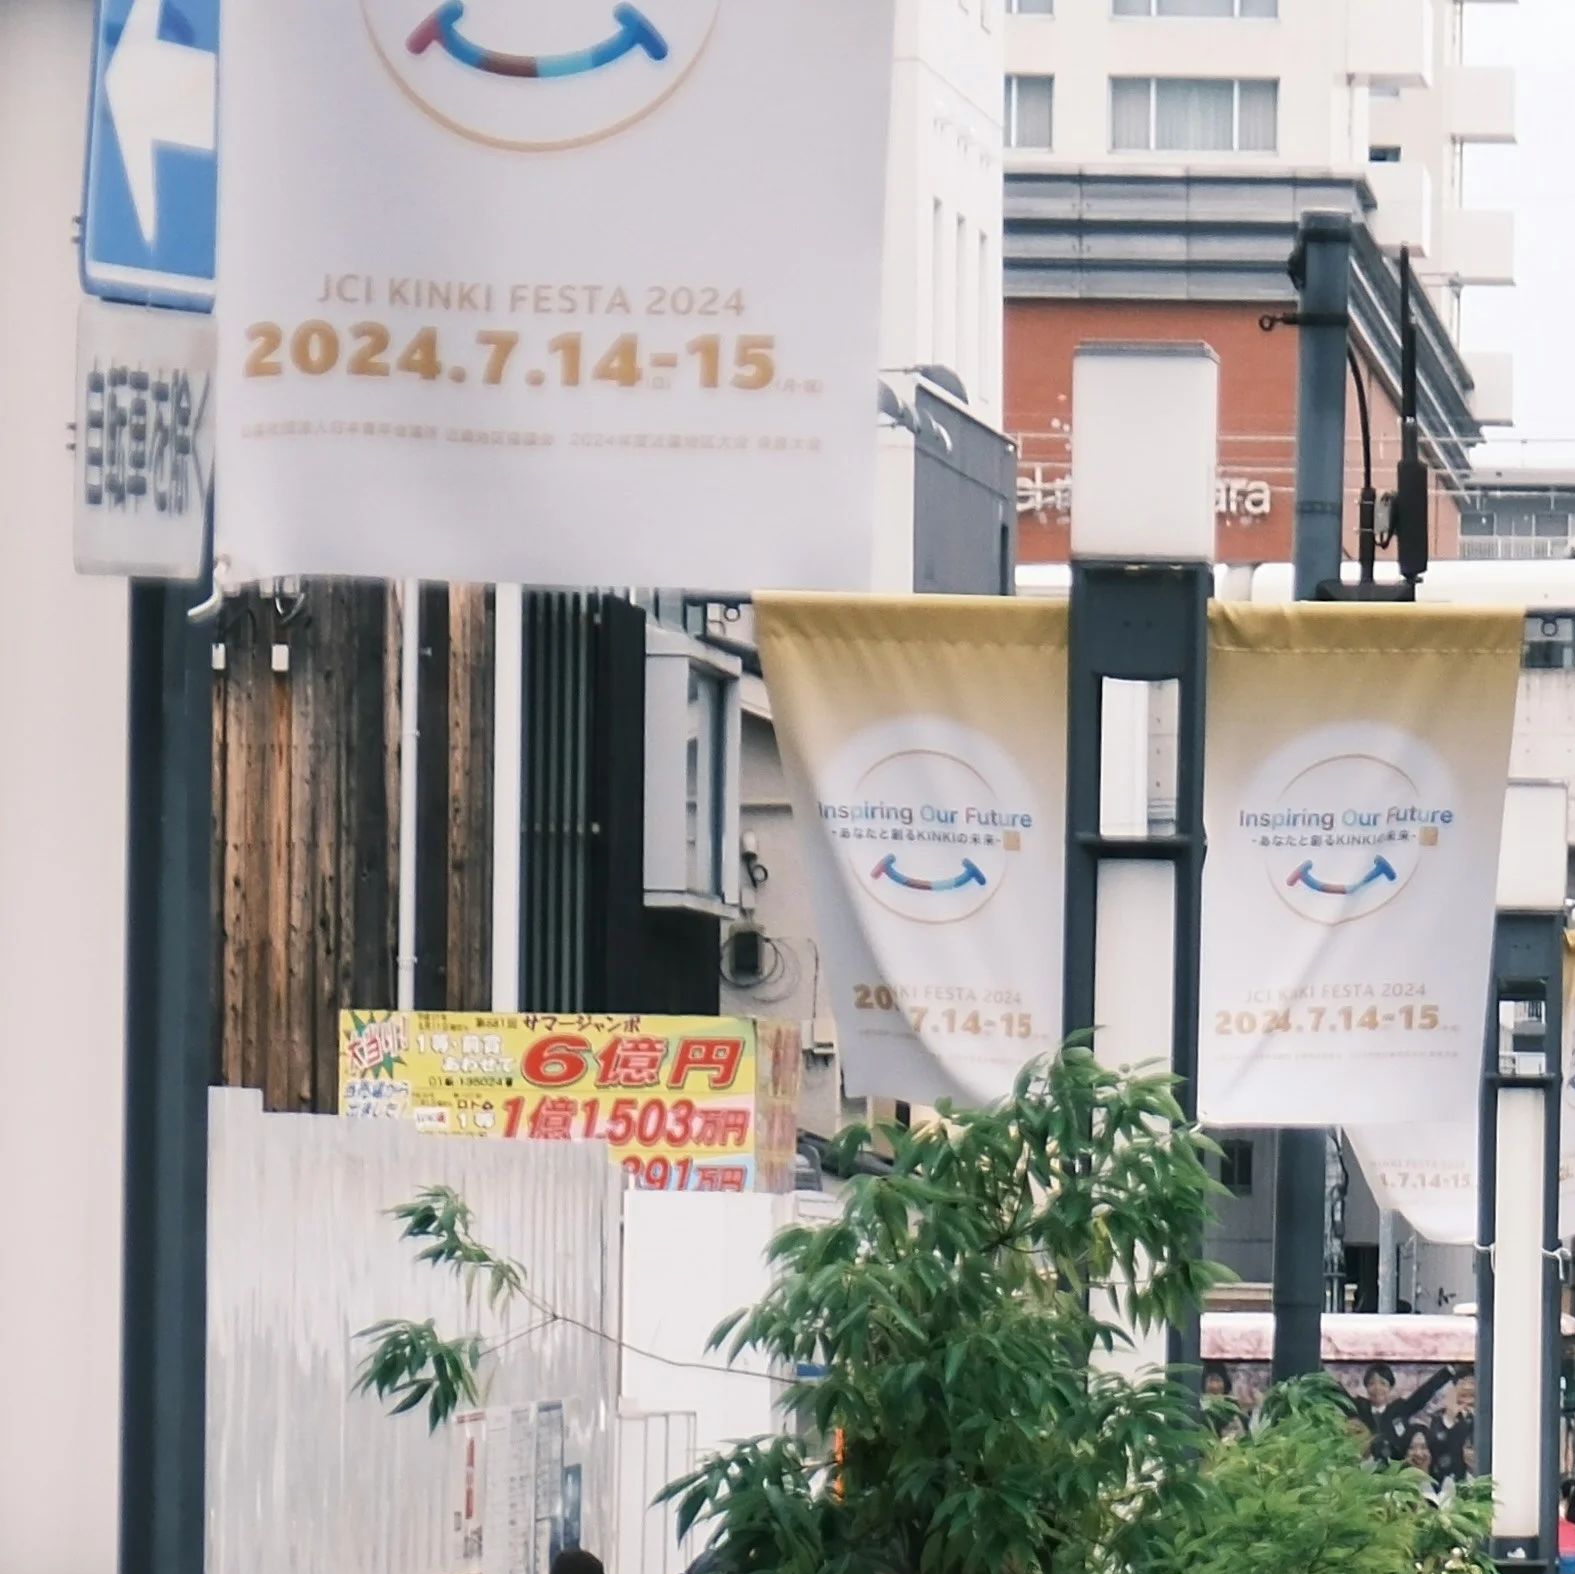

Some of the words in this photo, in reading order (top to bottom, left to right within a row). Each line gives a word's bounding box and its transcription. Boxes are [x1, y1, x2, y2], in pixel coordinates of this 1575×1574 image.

[316, 274, 373, 305] JCI
[390, 278, 492, 311] KINKI
[510, 285, 631, 315] FESTA
[646, 286, 746, 317] 2024
[817, 801, 914, 825] Inspiring
[920, 803, 958, 823] Our
[965, 807, 1033, 828] Future
[1239, 808, 1335, 830] Inspiring
[1342, 808, 1381, 827] Our
[1386, 804, 1454, 825] Future
[1381, 982, 1427, 998] 2024
[520, 1032, 745, 1089] 6億円
